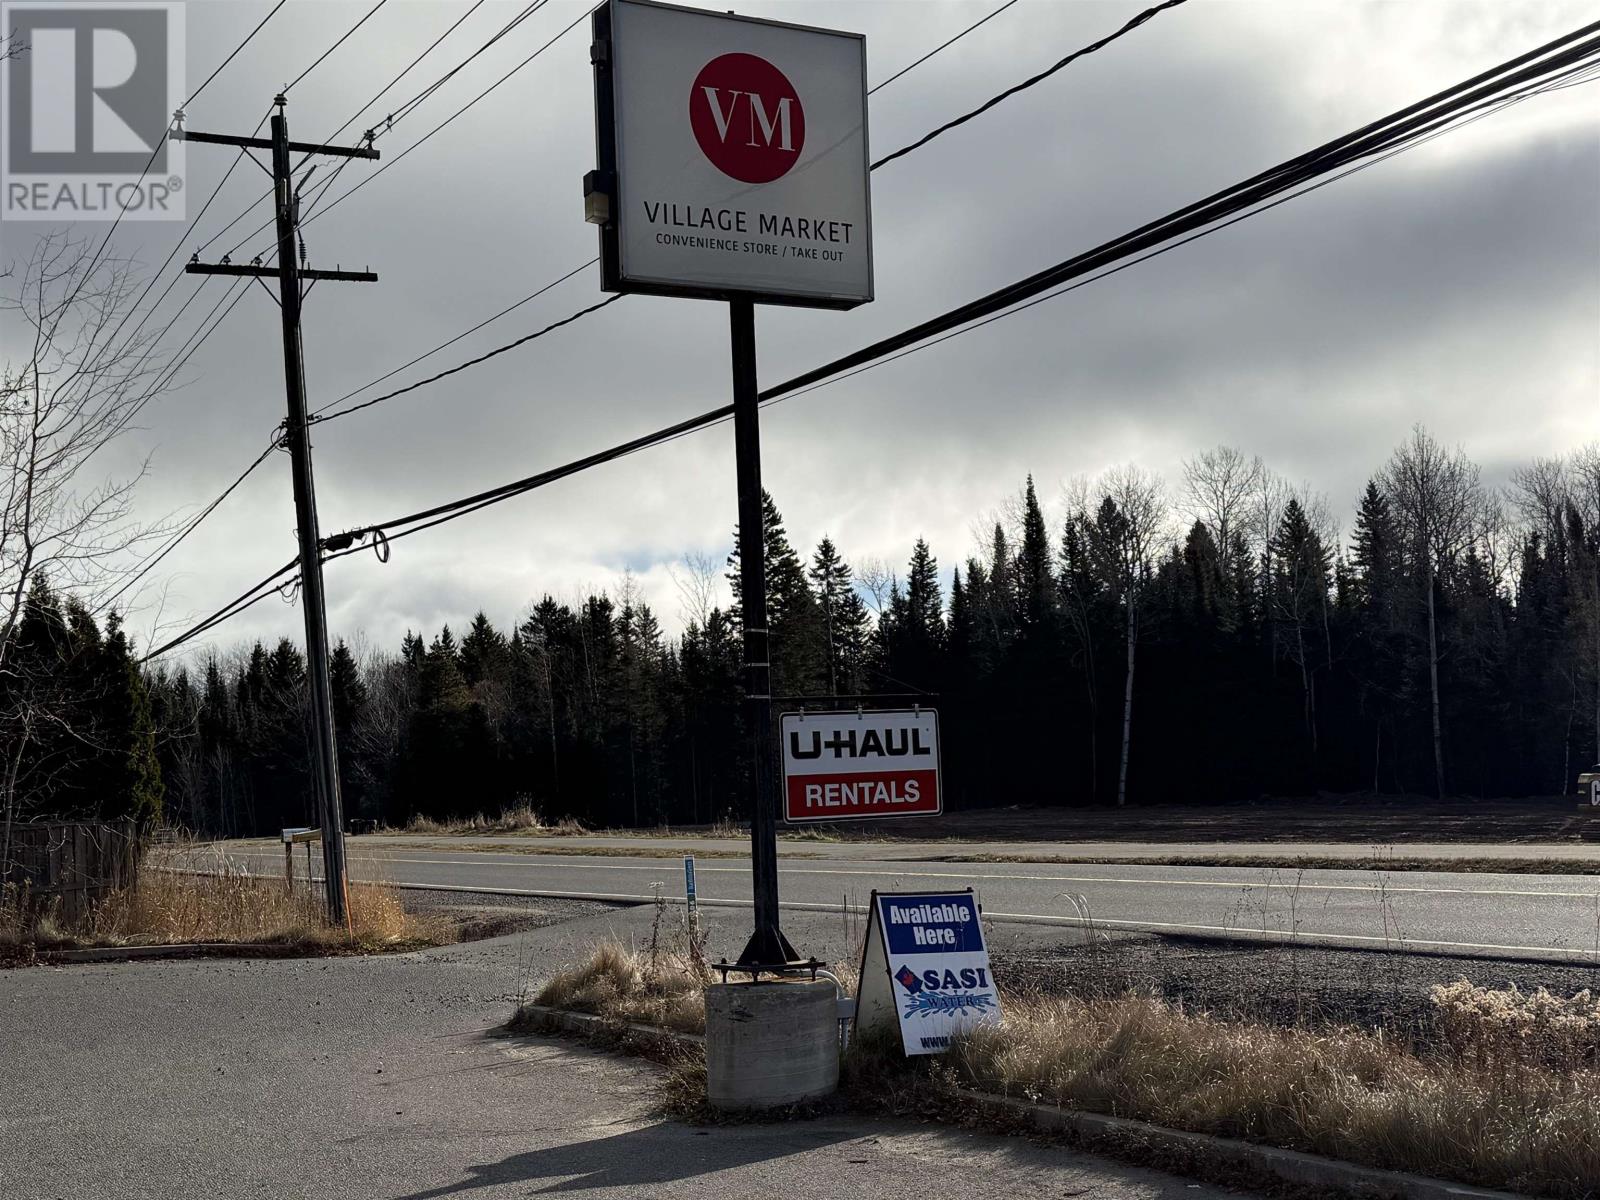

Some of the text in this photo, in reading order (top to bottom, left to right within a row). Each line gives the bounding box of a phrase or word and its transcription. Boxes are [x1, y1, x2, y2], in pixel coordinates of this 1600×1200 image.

[700, 86, 796, 151] VM
[643, 201, 853, 244] VILLAGE MARKET
[655, 233, 739, 252] CONVENIENCE
[743, 241, 778, 256] STORE
[791, 246, 818, 260] TAKE
[822, 250, 844, 262] OUT
[790, 728, 931, 760] U-HAUL
[805, 779, 921, 807] RENTALS
[890, 904, 971, 924] Available
[913, 926, 956, 945] Here
[922, 968, 989, 990] SASI
[926, 996, 975, 1009] WATER
